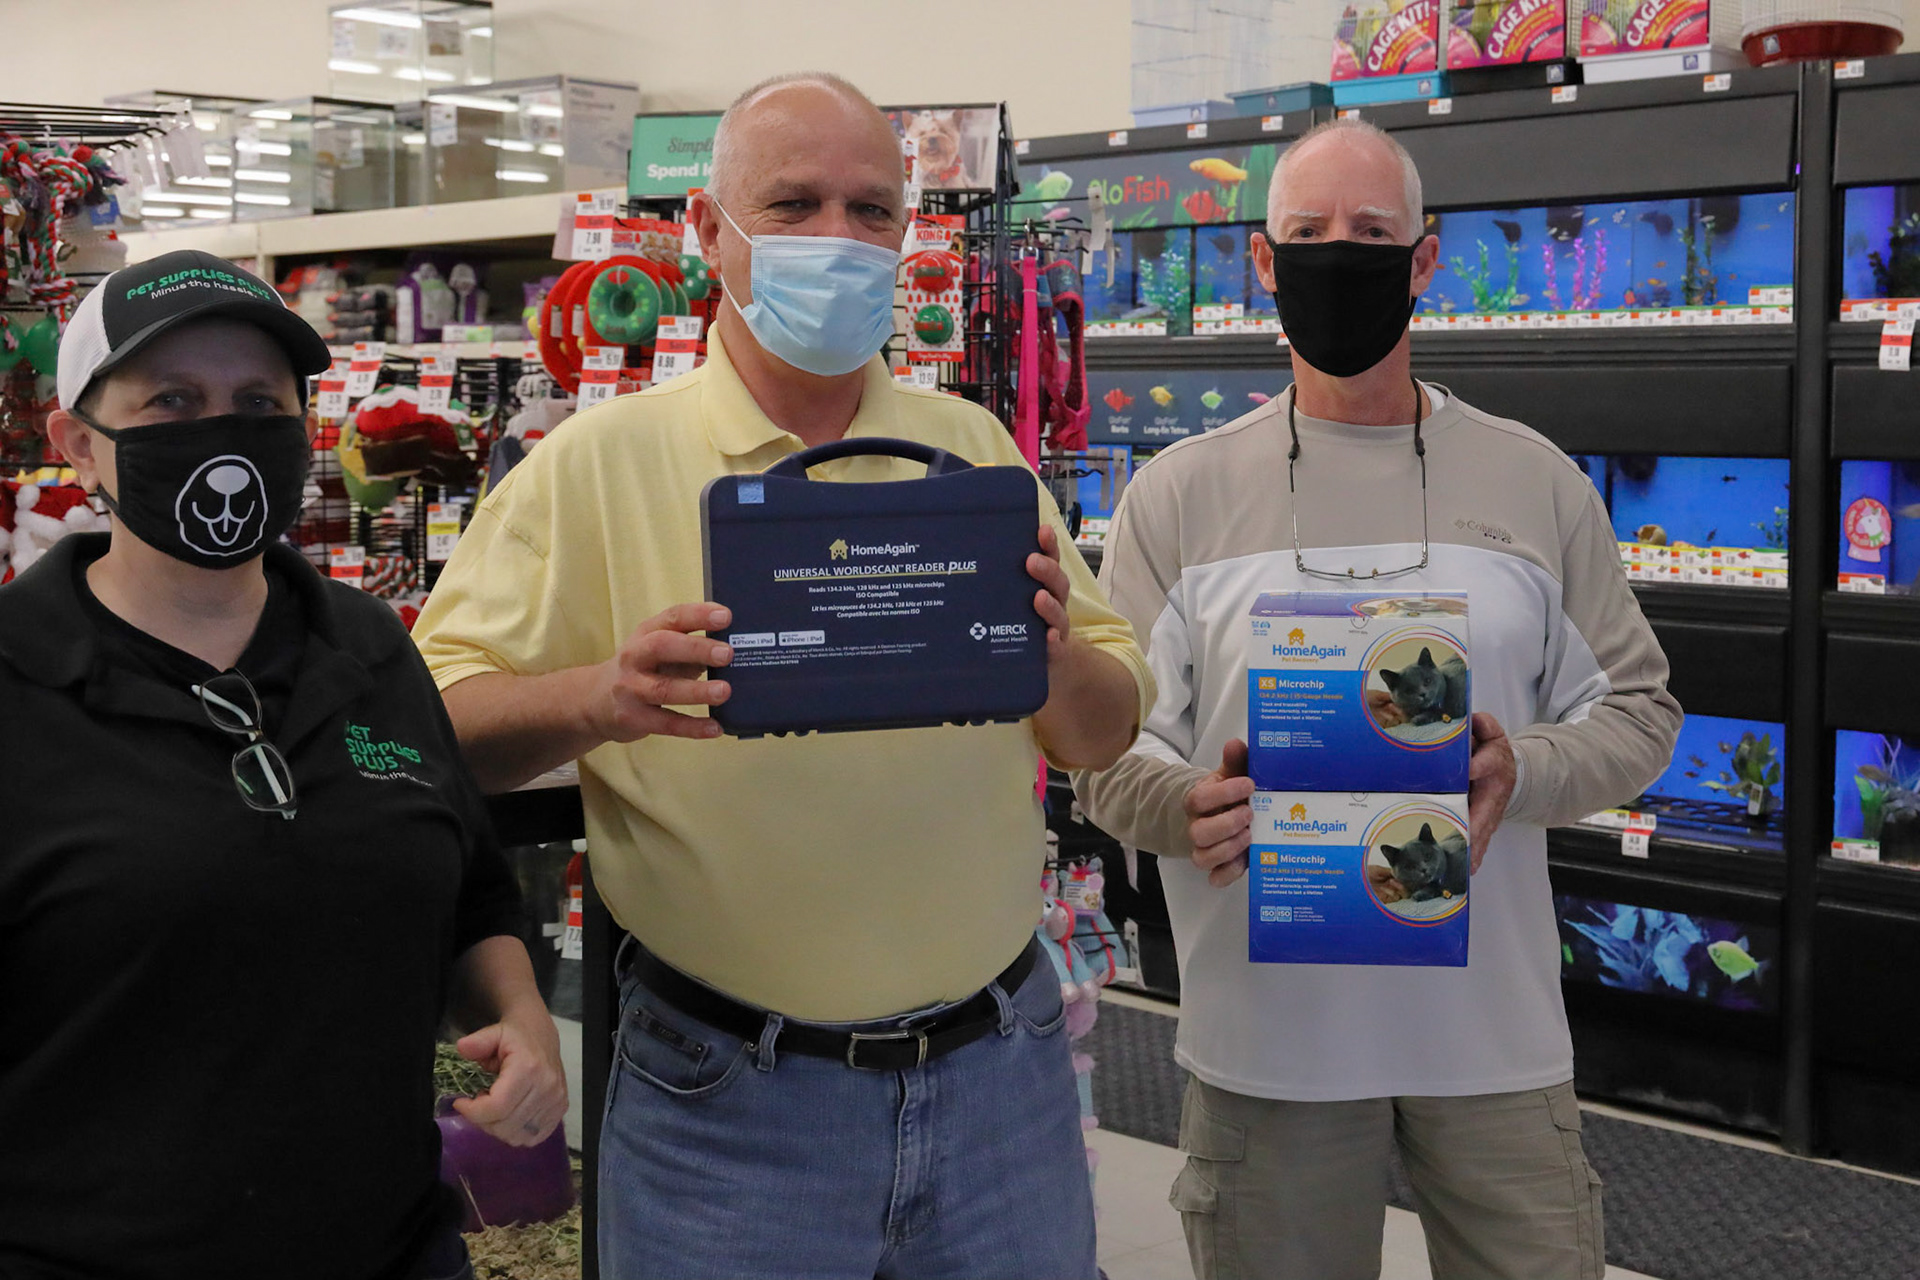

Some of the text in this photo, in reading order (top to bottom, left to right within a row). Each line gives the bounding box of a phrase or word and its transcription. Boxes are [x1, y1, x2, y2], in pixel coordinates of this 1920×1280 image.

[1368, 20, 1401, 72] CAGE
[1397, 1, 1430, 31] KIT!
[1488, 6, 1523, 59] CAGE
[647, 163, 699, 181] Spend
[916, 229, 943, 241] KONG
[126, 268, 271, 301] PET SUPPLIES PLUS
[150, 279, 258, 299] Minus the hassle.
[773, 566, 831, 578] UNIVERSAL
[905, 562, 944, 573] READER
[866, 590, 900, 598] Compatible
[828, 604, 858, 612] micropuces
[990, 624, 1028, 636] MERCK
[1262, 679, 1324, 689] XS Microchip
[345, 737, 422, 764] SUPPLIES
[351, 753, 399, 771] PLUS
[1263, 854, 1325, 865] XS Microchip
